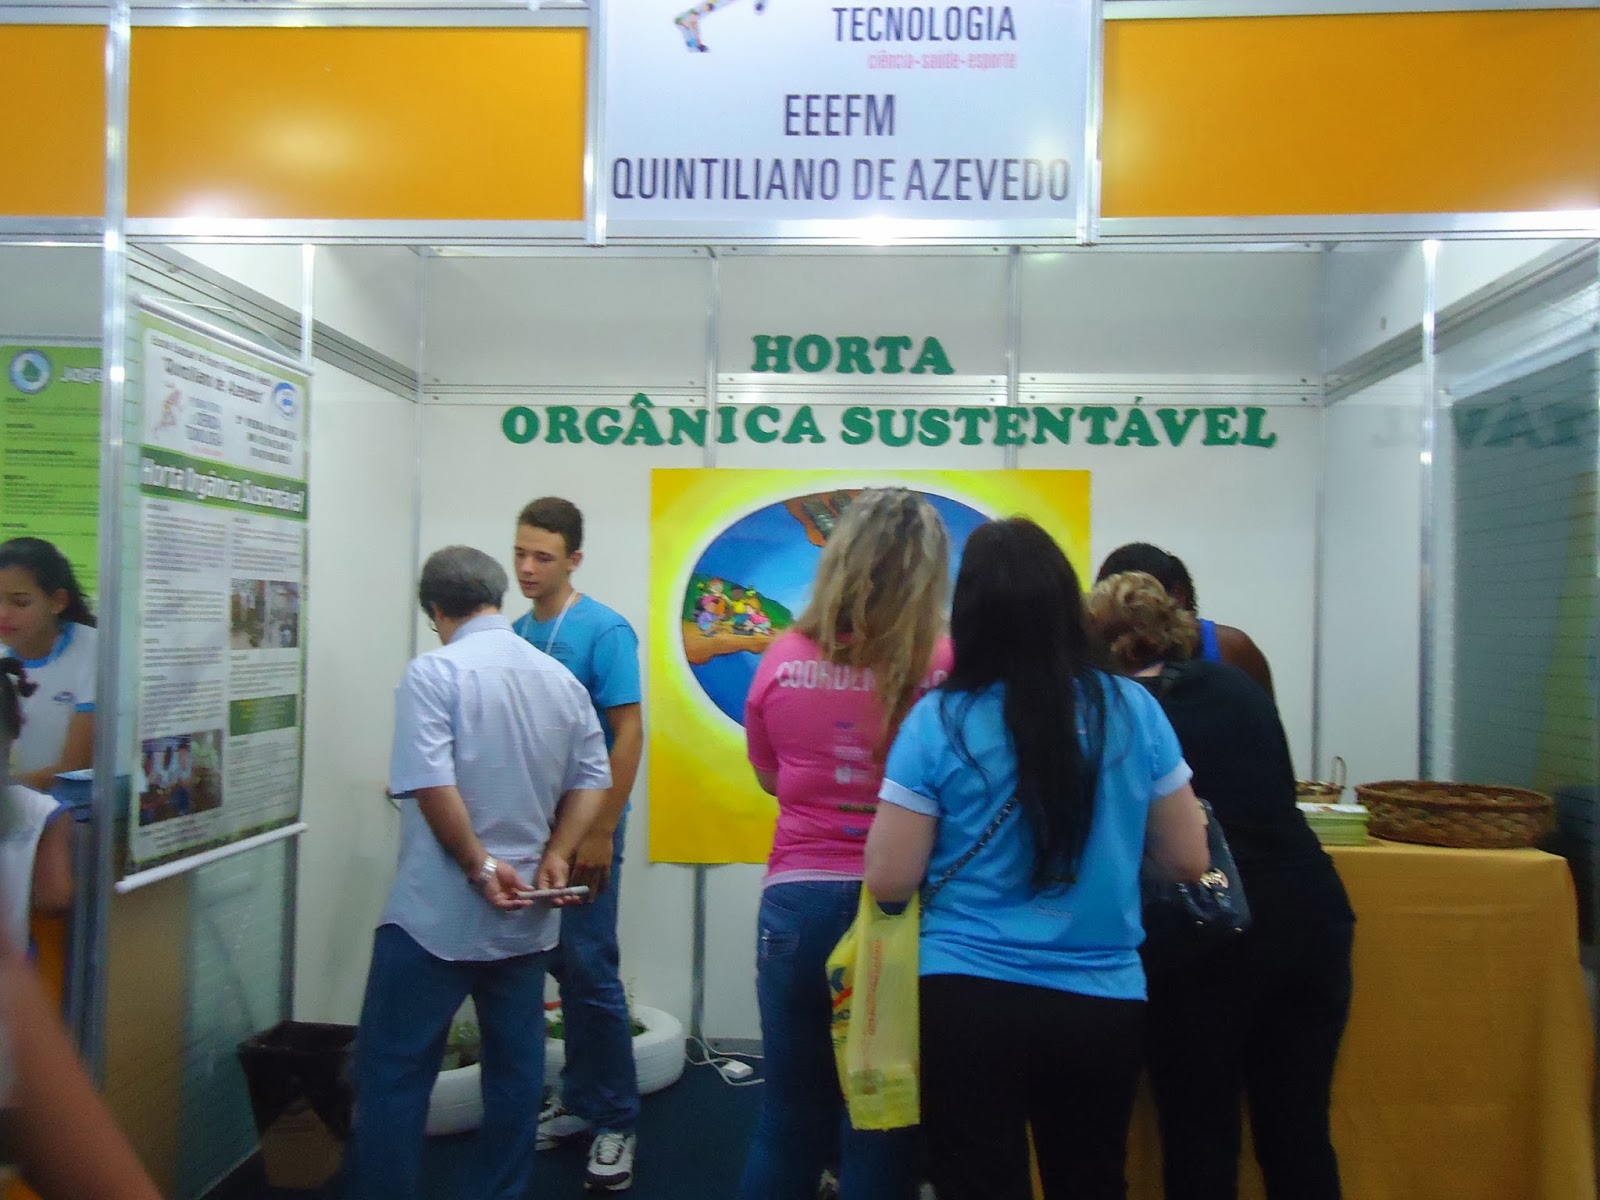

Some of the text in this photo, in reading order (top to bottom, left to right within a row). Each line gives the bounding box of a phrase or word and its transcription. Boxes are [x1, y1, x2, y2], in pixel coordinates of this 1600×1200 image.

[833, 6, 1016, 42] TECNOLOGIA
[784, 94, 895, 136] EEEFM
[612, 157, 1070, 201] QUINTILIANO DE AZEVEDO
[752, 334, 955, 375] HORTA
[501, 392, 1278, 448] ORGÂNICA SUSTENTÁVEL
